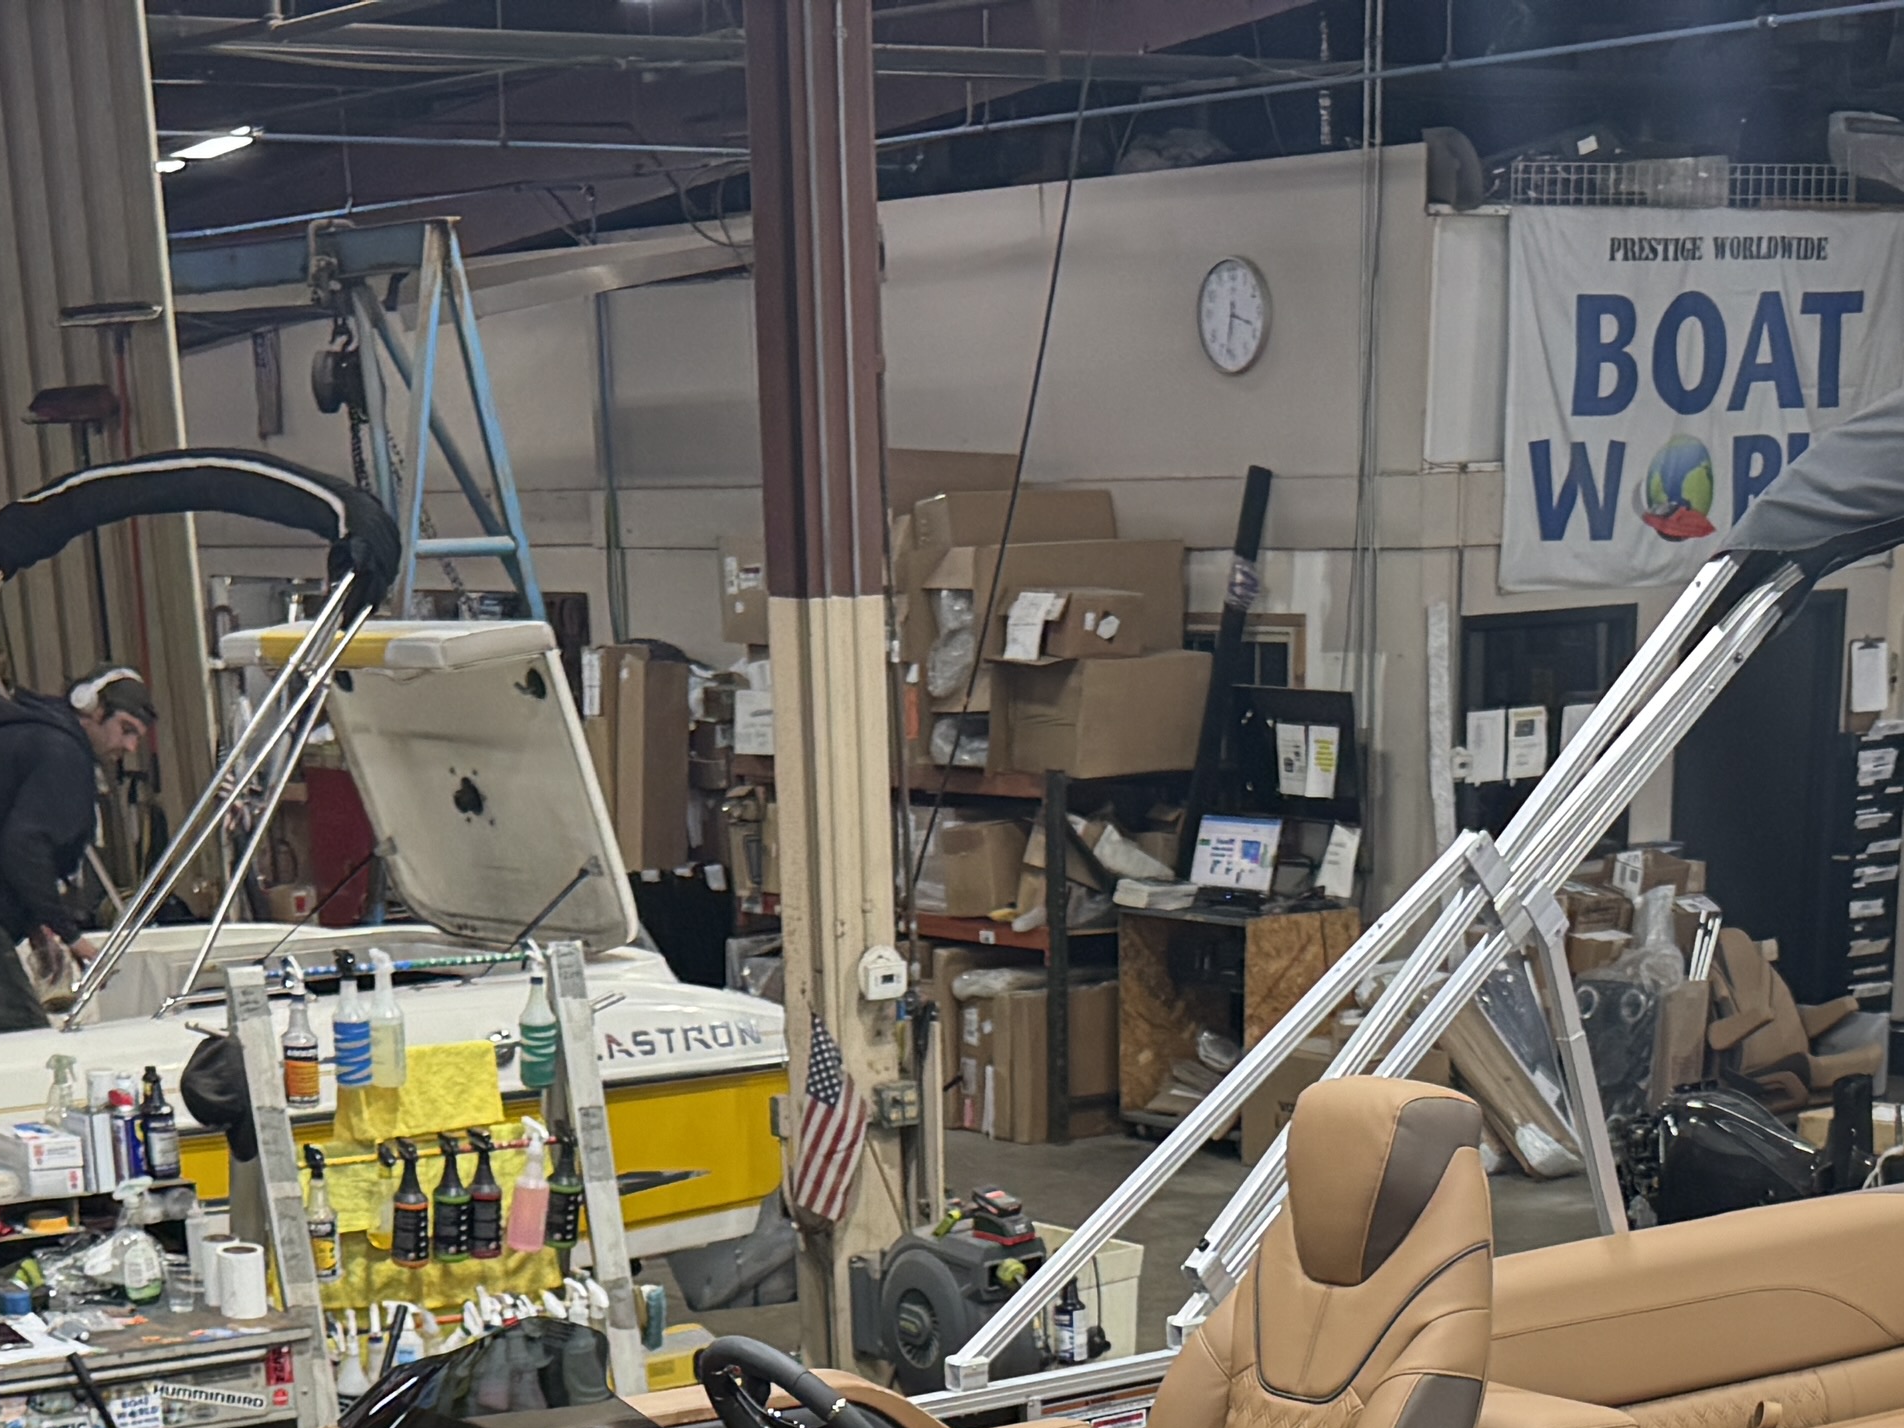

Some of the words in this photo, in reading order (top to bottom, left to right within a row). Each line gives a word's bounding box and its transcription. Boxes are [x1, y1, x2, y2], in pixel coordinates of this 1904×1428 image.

[1609, 236, 1704, 262] PRESTIGE
[1713, 236, 1829, 261] WORLDWIDE
[1571, 290, 1864, 416] BOAT
[153, 1384, 264, 1408] HUMMINBIRD
